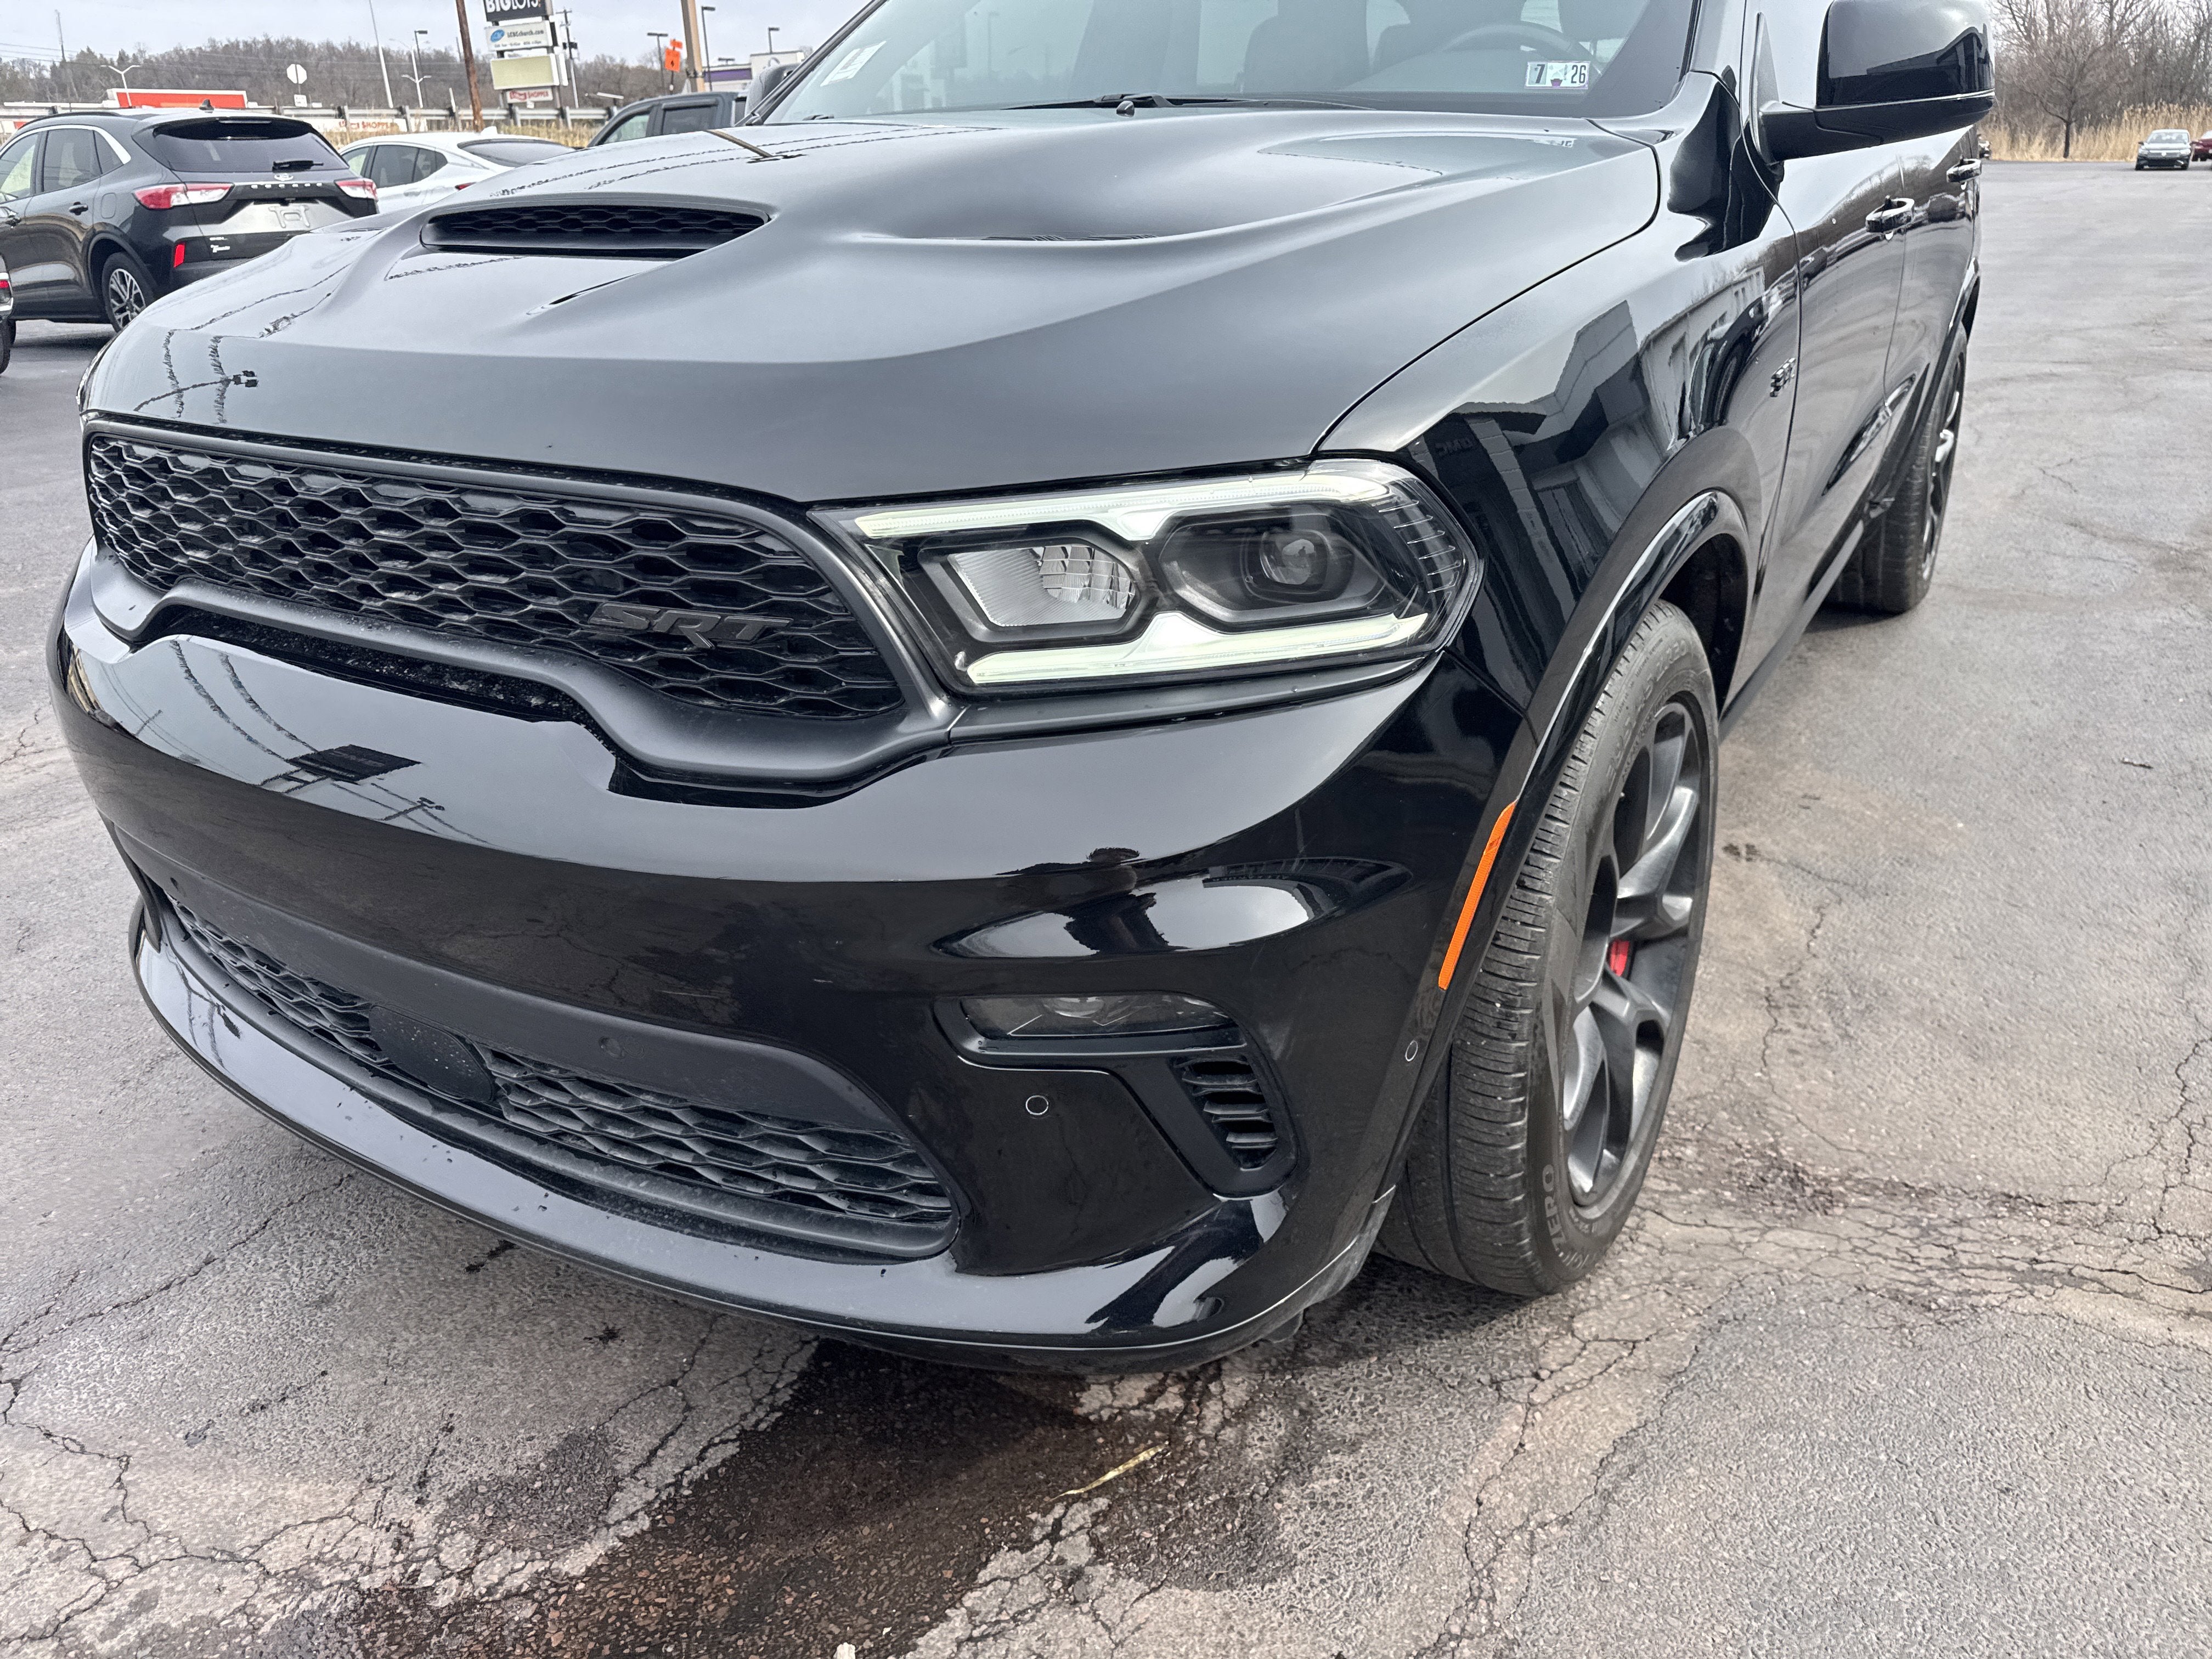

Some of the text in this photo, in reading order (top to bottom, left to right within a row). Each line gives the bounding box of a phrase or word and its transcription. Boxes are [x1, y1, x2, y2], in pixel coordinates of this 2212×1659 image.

[1536, 64, 1545, 83] 7
[1571, 65, 1587, 83] 26
[588, 602, 794, 649] SRT
[1542, 1164, 1566, 1252] ZERO
